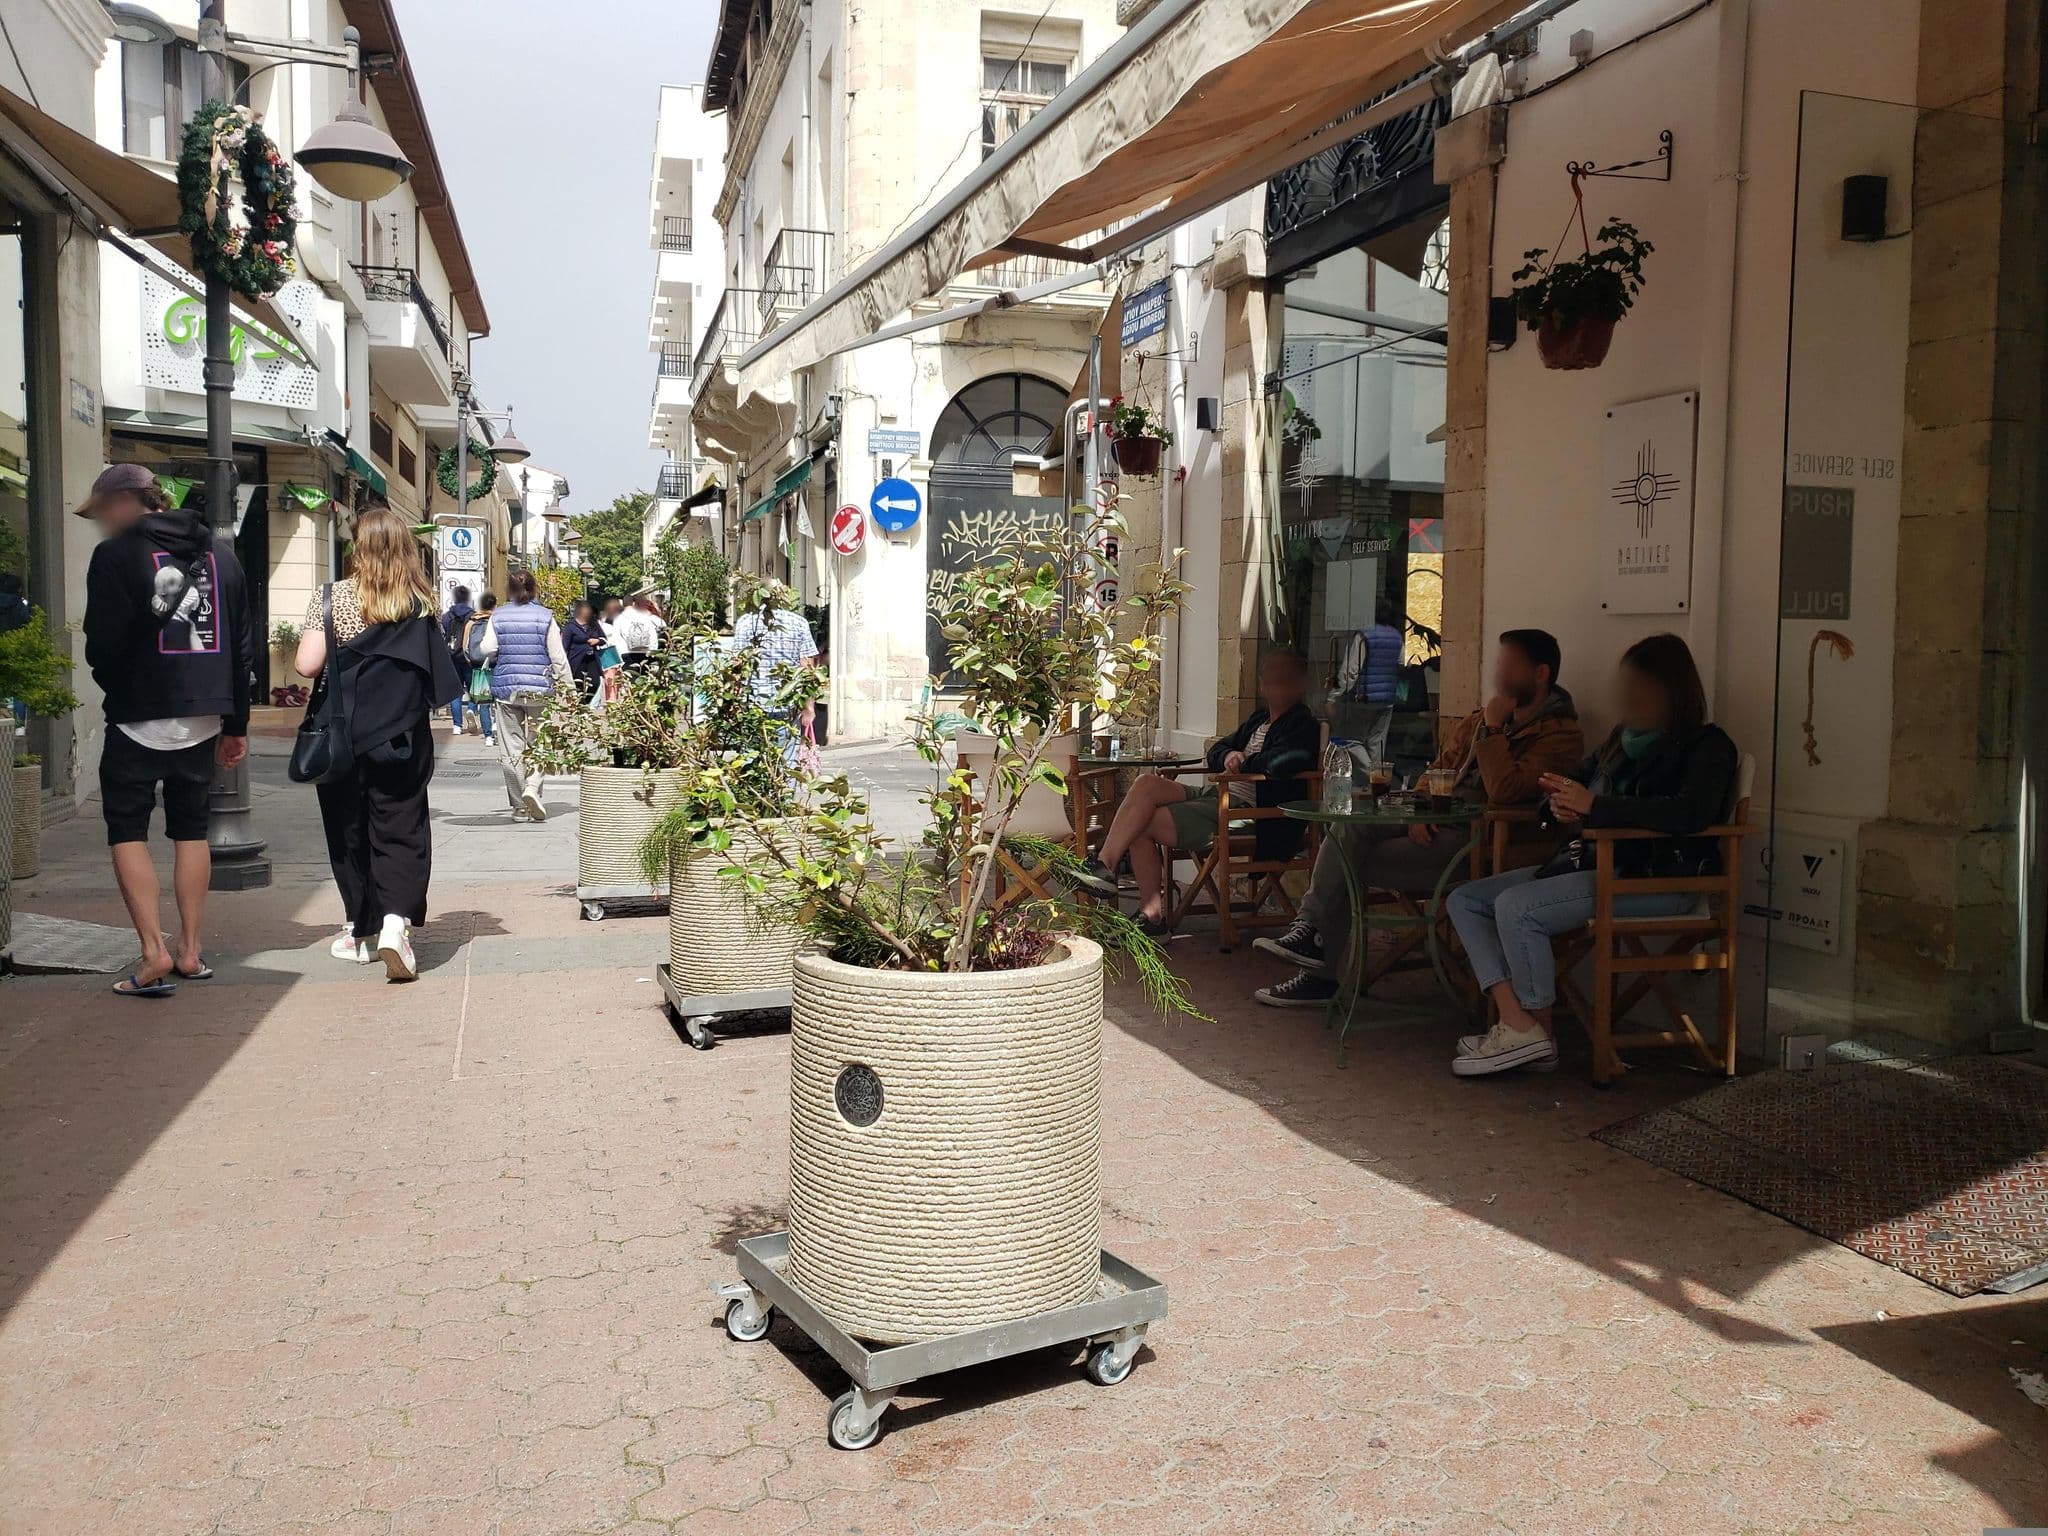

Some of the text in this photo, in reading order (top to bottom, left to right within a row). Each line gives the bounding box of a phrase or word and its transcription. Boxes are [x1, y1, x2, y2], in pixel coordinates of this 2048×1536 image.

[1789, 492, 1851, 517] PUSH
[1352, 538, 1391, 554] SELF SERVICE
[1100, 589, 1117, 602] 15
